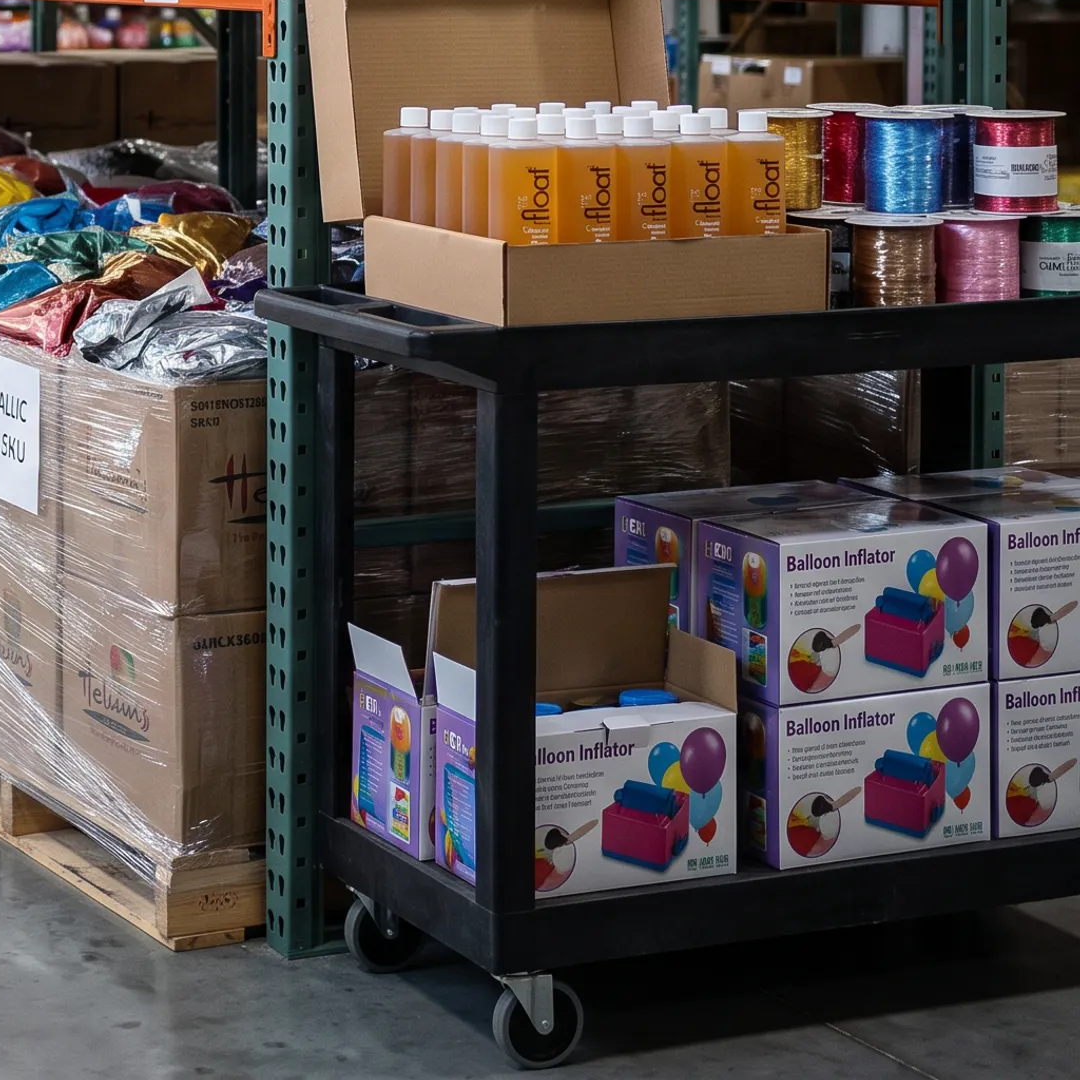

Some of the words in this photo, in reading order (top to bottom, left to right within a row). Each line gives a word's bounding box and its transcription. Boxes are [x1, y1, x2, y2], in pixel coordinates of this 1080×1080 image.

[521, 167, 550, 221] float
[584, 165, 611, 219] float
[640, 163, 667, 217] float
[692, 160, 720, 213] float
[753, 158, 780, 211] float
[1, 433, 26, 463] SKU
[1008, 531, 1058, 550] Balloon
[787, 553, 840, 572] Balloon
[844, 548, 895, 567] Inflator
[1006, 691, 1056, 710] Balloon
[786, 717, 840, 737] Balloon
[844, 711, 895, 730] Inflator
[536, 747, 575, 765] lloon
[580, 742, 635, 761] Inflator
